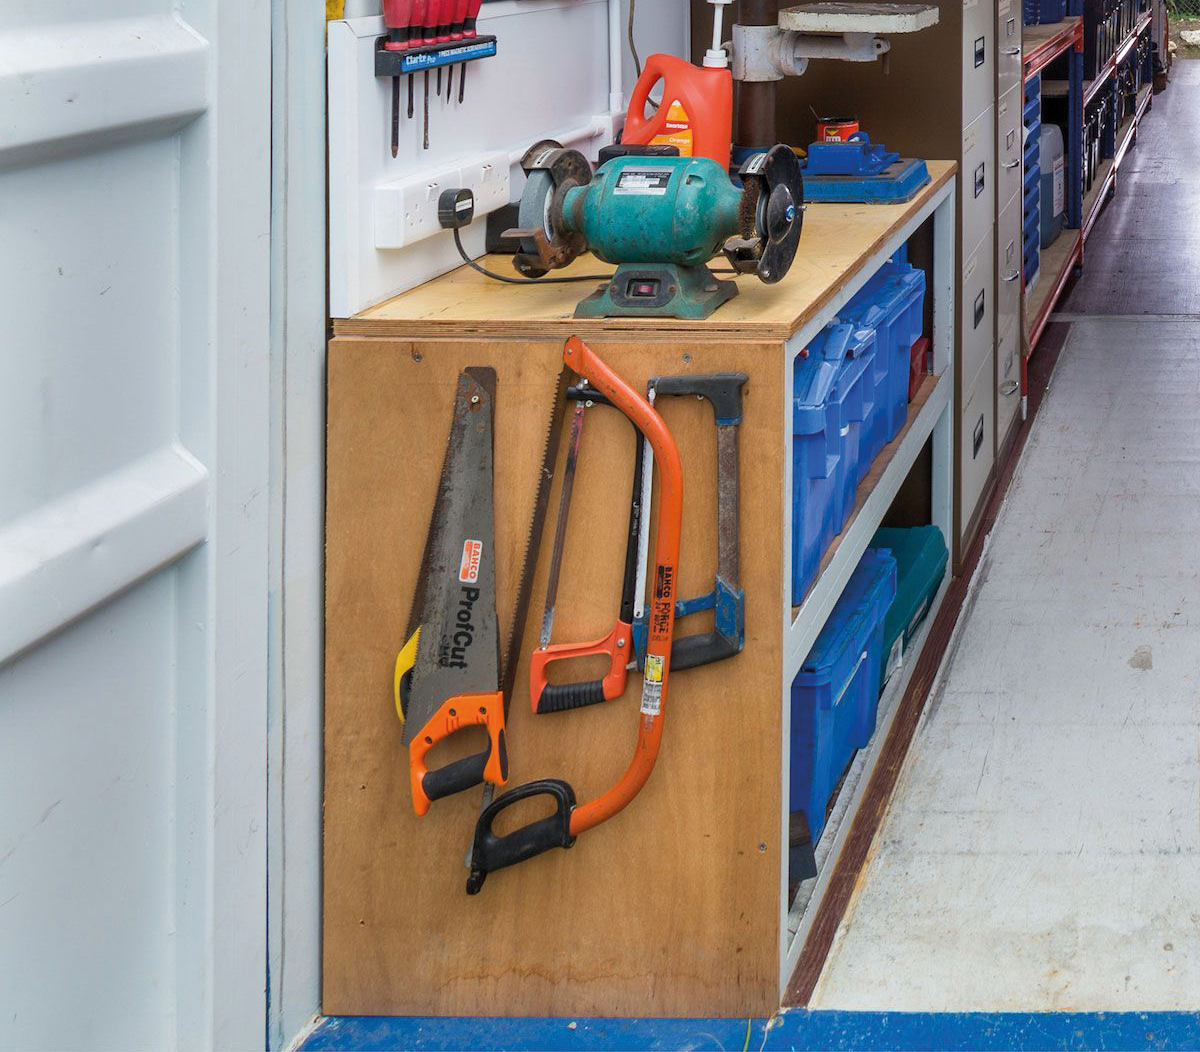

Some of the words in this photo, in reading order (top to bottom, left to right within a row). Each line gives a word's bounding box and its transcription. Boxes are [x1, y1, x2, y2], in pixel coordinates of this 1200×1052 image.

[406, 54, 427, 65] Clarke
[469, 542, 481, 580] BAHCO
[663, 565, 673, 598] BAHCO
[450, 586, 480, 669] ProfCut
[658, 602, 671, 634] FORCE
